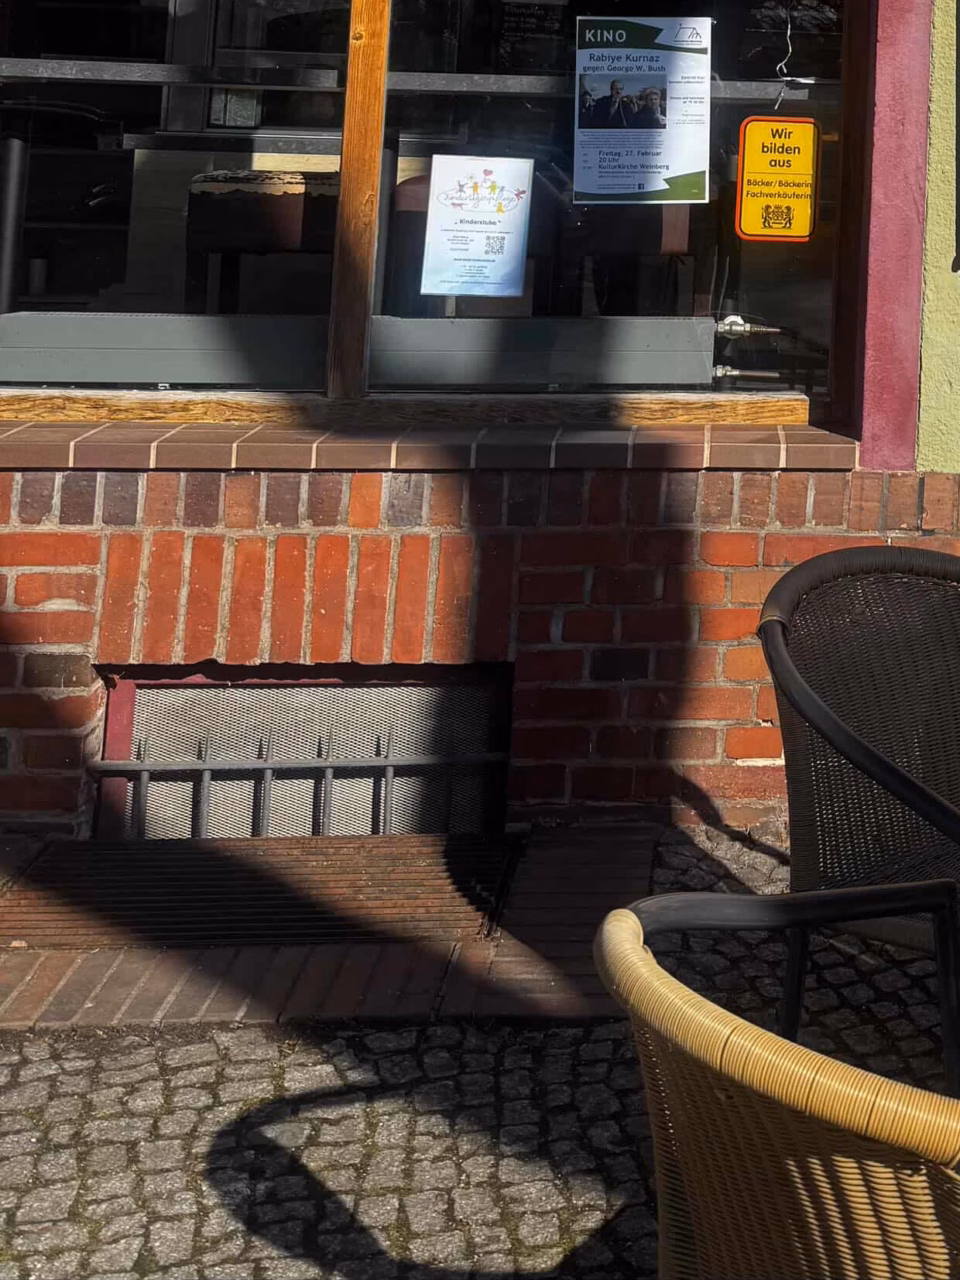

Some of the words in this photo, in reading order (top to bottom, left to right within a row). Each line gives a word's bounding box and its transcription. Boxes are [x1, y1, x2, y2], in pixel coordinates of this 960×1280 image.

[585, 29, 627, 43] KINO
[589, 52, 622, 63] Rabiye
[625, 53, 660, 63] Kurnaz
[582, 65, 606, 73] gegen
[607, 64, 634, 73] George
[635, 65, 646, 73] W.
[648, 65, 666, 73] Bush
[770, 127, 793, 140] Wir
[762, 142, 801, 155] bilden
[640, 163, 670, 171] Weinberg
[769, 158, 792, 168] aus
[745, 190, 812, 200] Fachverkäuferin
